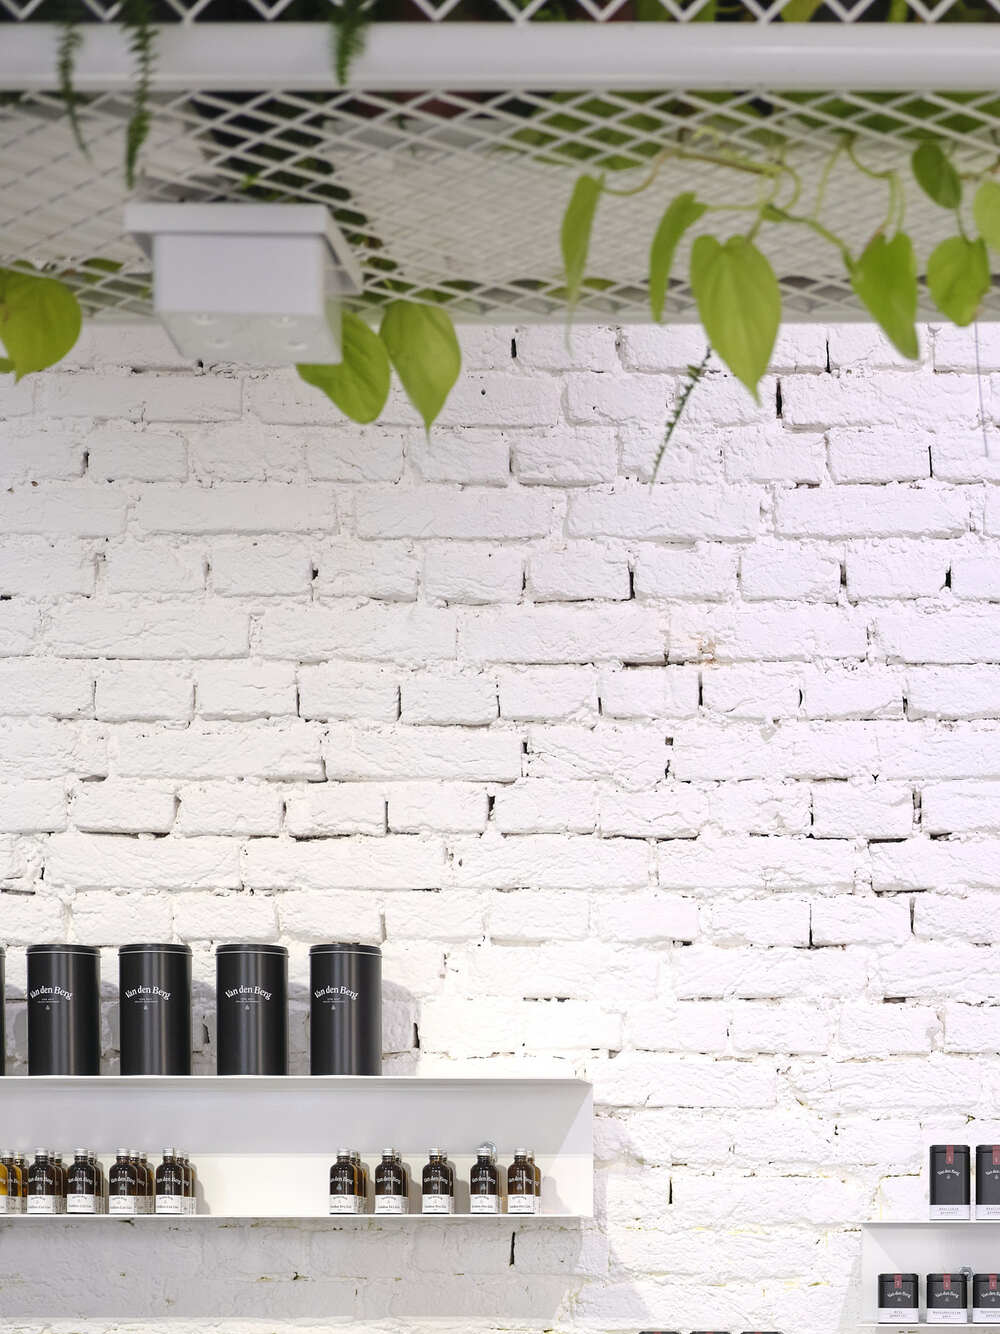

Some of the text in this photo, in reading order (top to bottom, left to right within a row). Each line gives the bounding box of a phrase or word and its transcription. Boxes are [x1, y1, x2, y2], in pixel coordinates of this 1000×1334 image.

[30, 985, 72, 1000] Van den Berg
[125, 985, 171, 1000] Van den Berg
[225, 985, 272, 1000] Van den Berg
[315, 985, 359, 1000] Van den Berg
